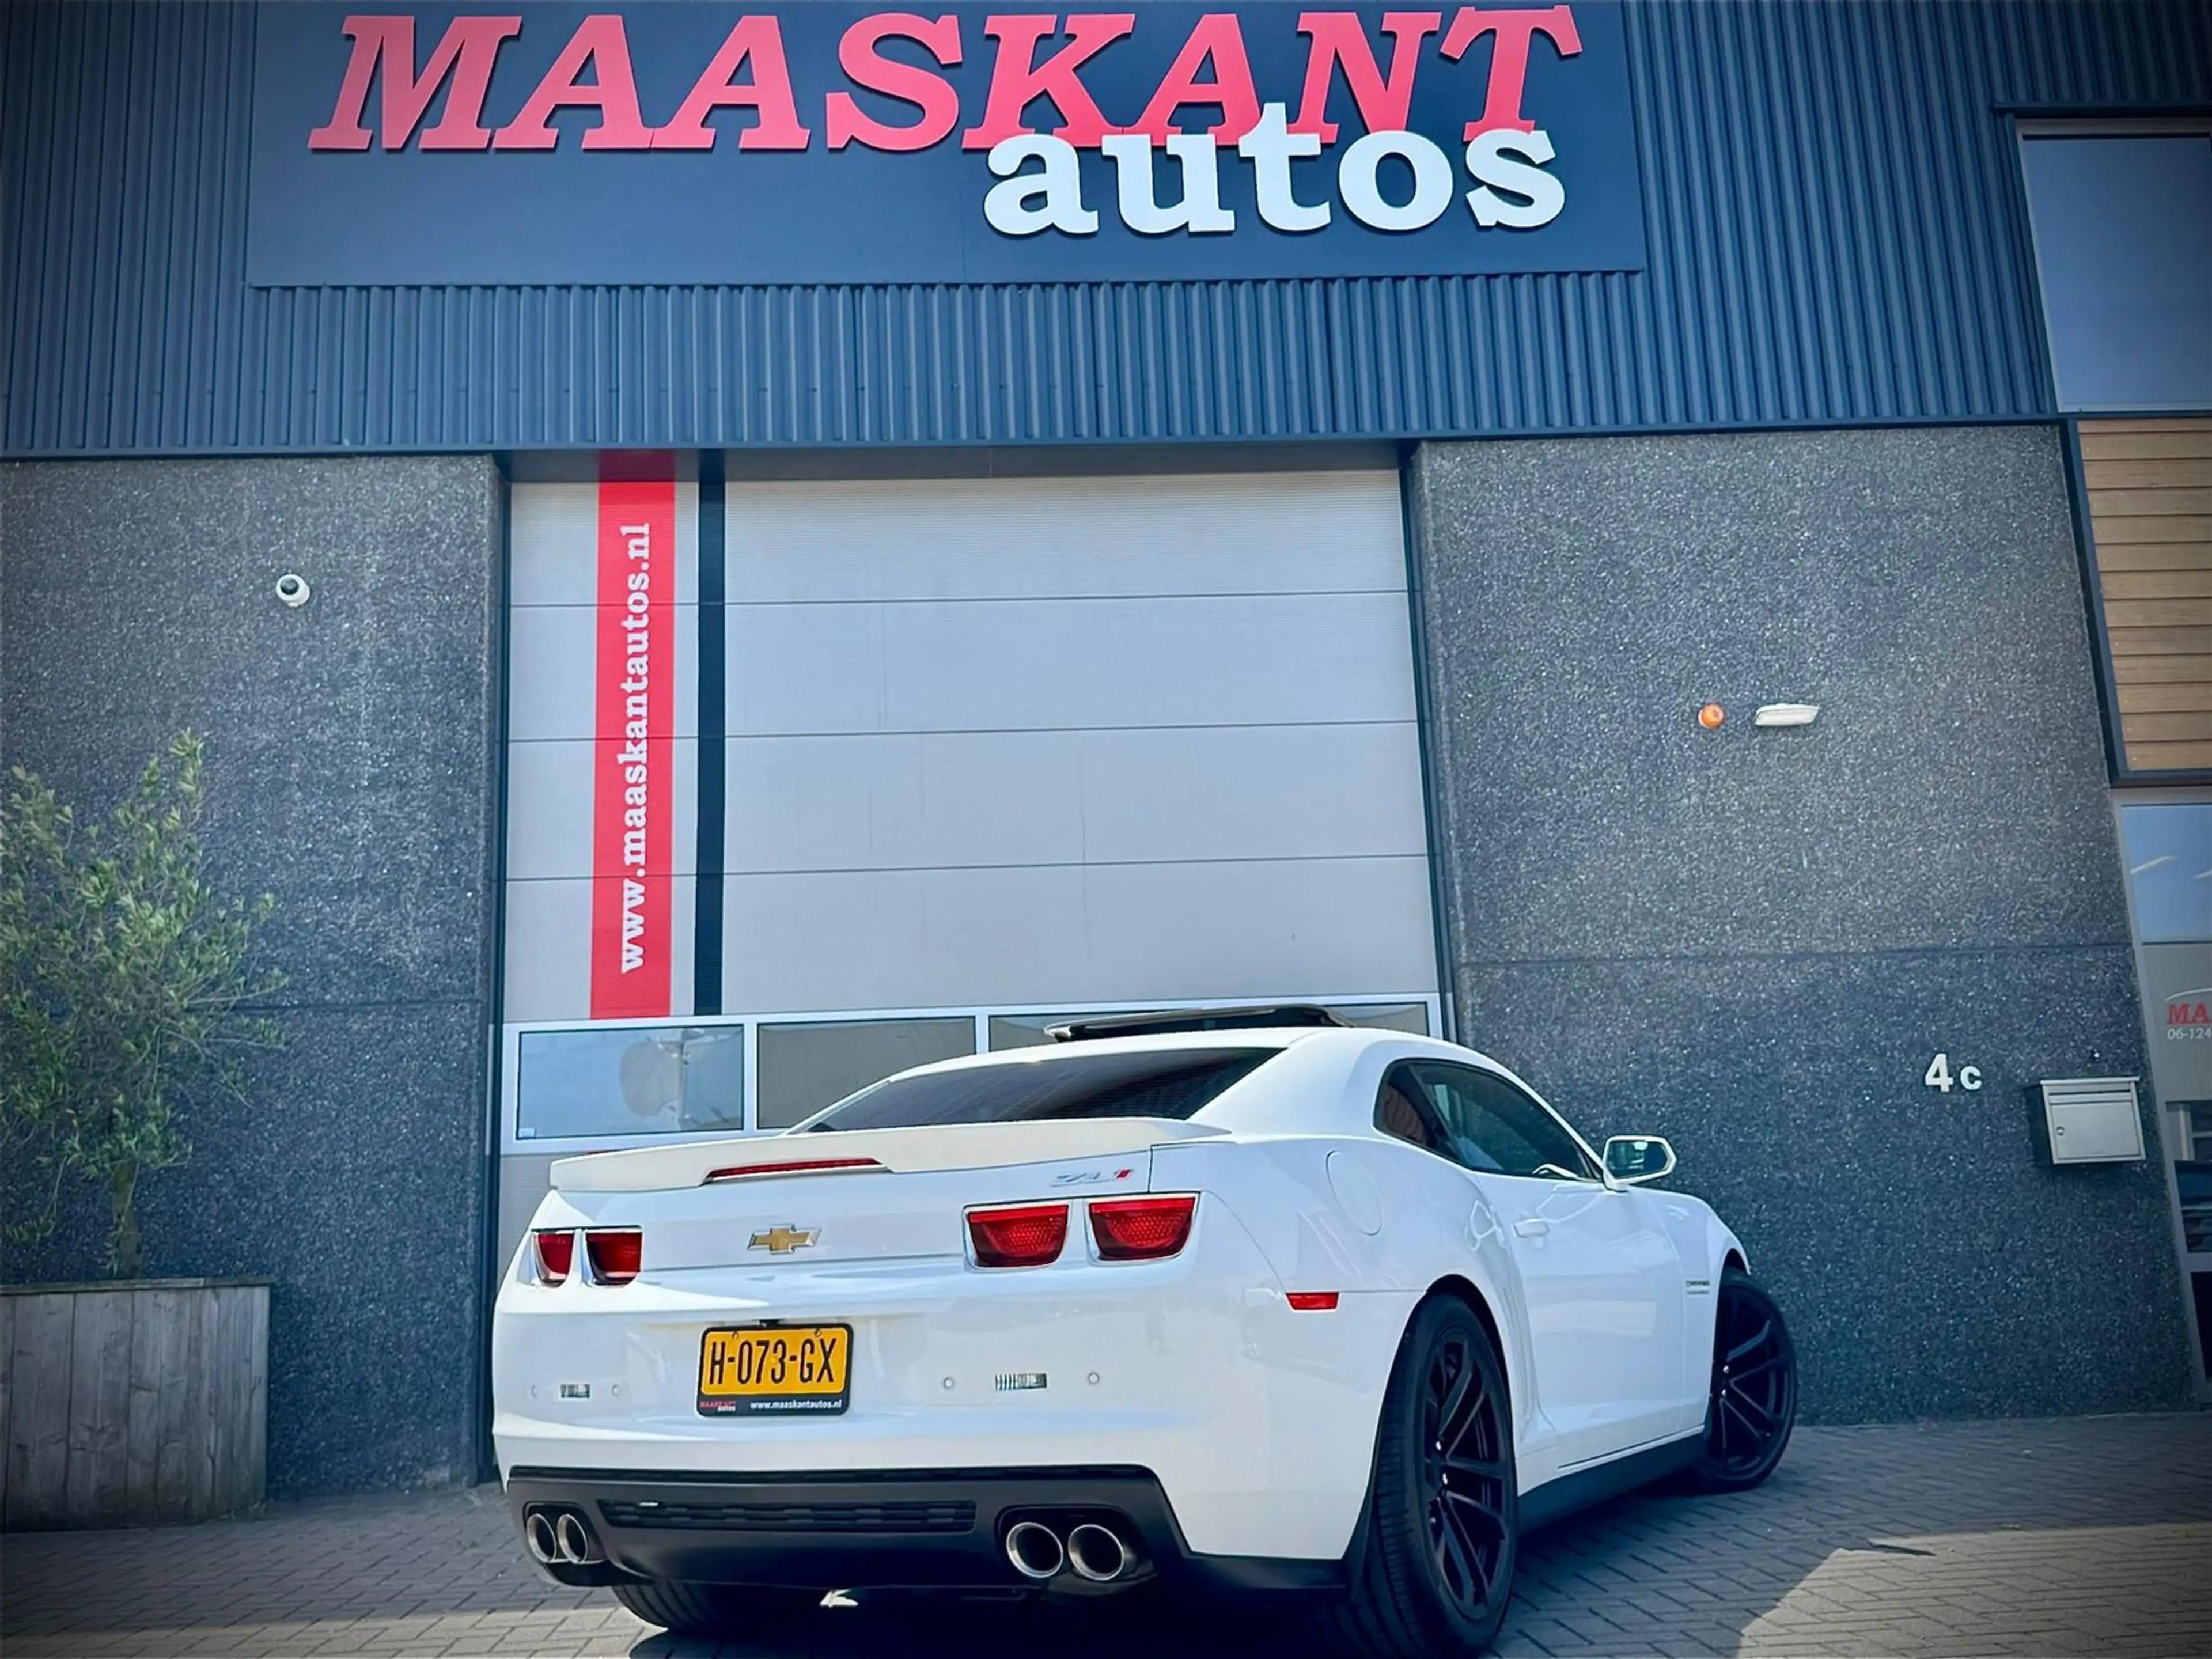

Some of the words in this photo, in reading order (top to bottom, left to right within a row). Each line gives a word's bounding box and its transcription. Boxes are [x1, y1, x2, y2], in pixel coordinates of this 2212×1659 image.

[308, 5, 1582, 150] MAASKANT
[983, 103, 1565, 234] autos
[619, 522, 651, 973] www.maaskantautos.nl
[2167, 1002, 2212, 1024] MA
[710, 1338, 837, 1385] H-073-GX
[750, 1399, 842, 1410] www.maaskantautos.nl
